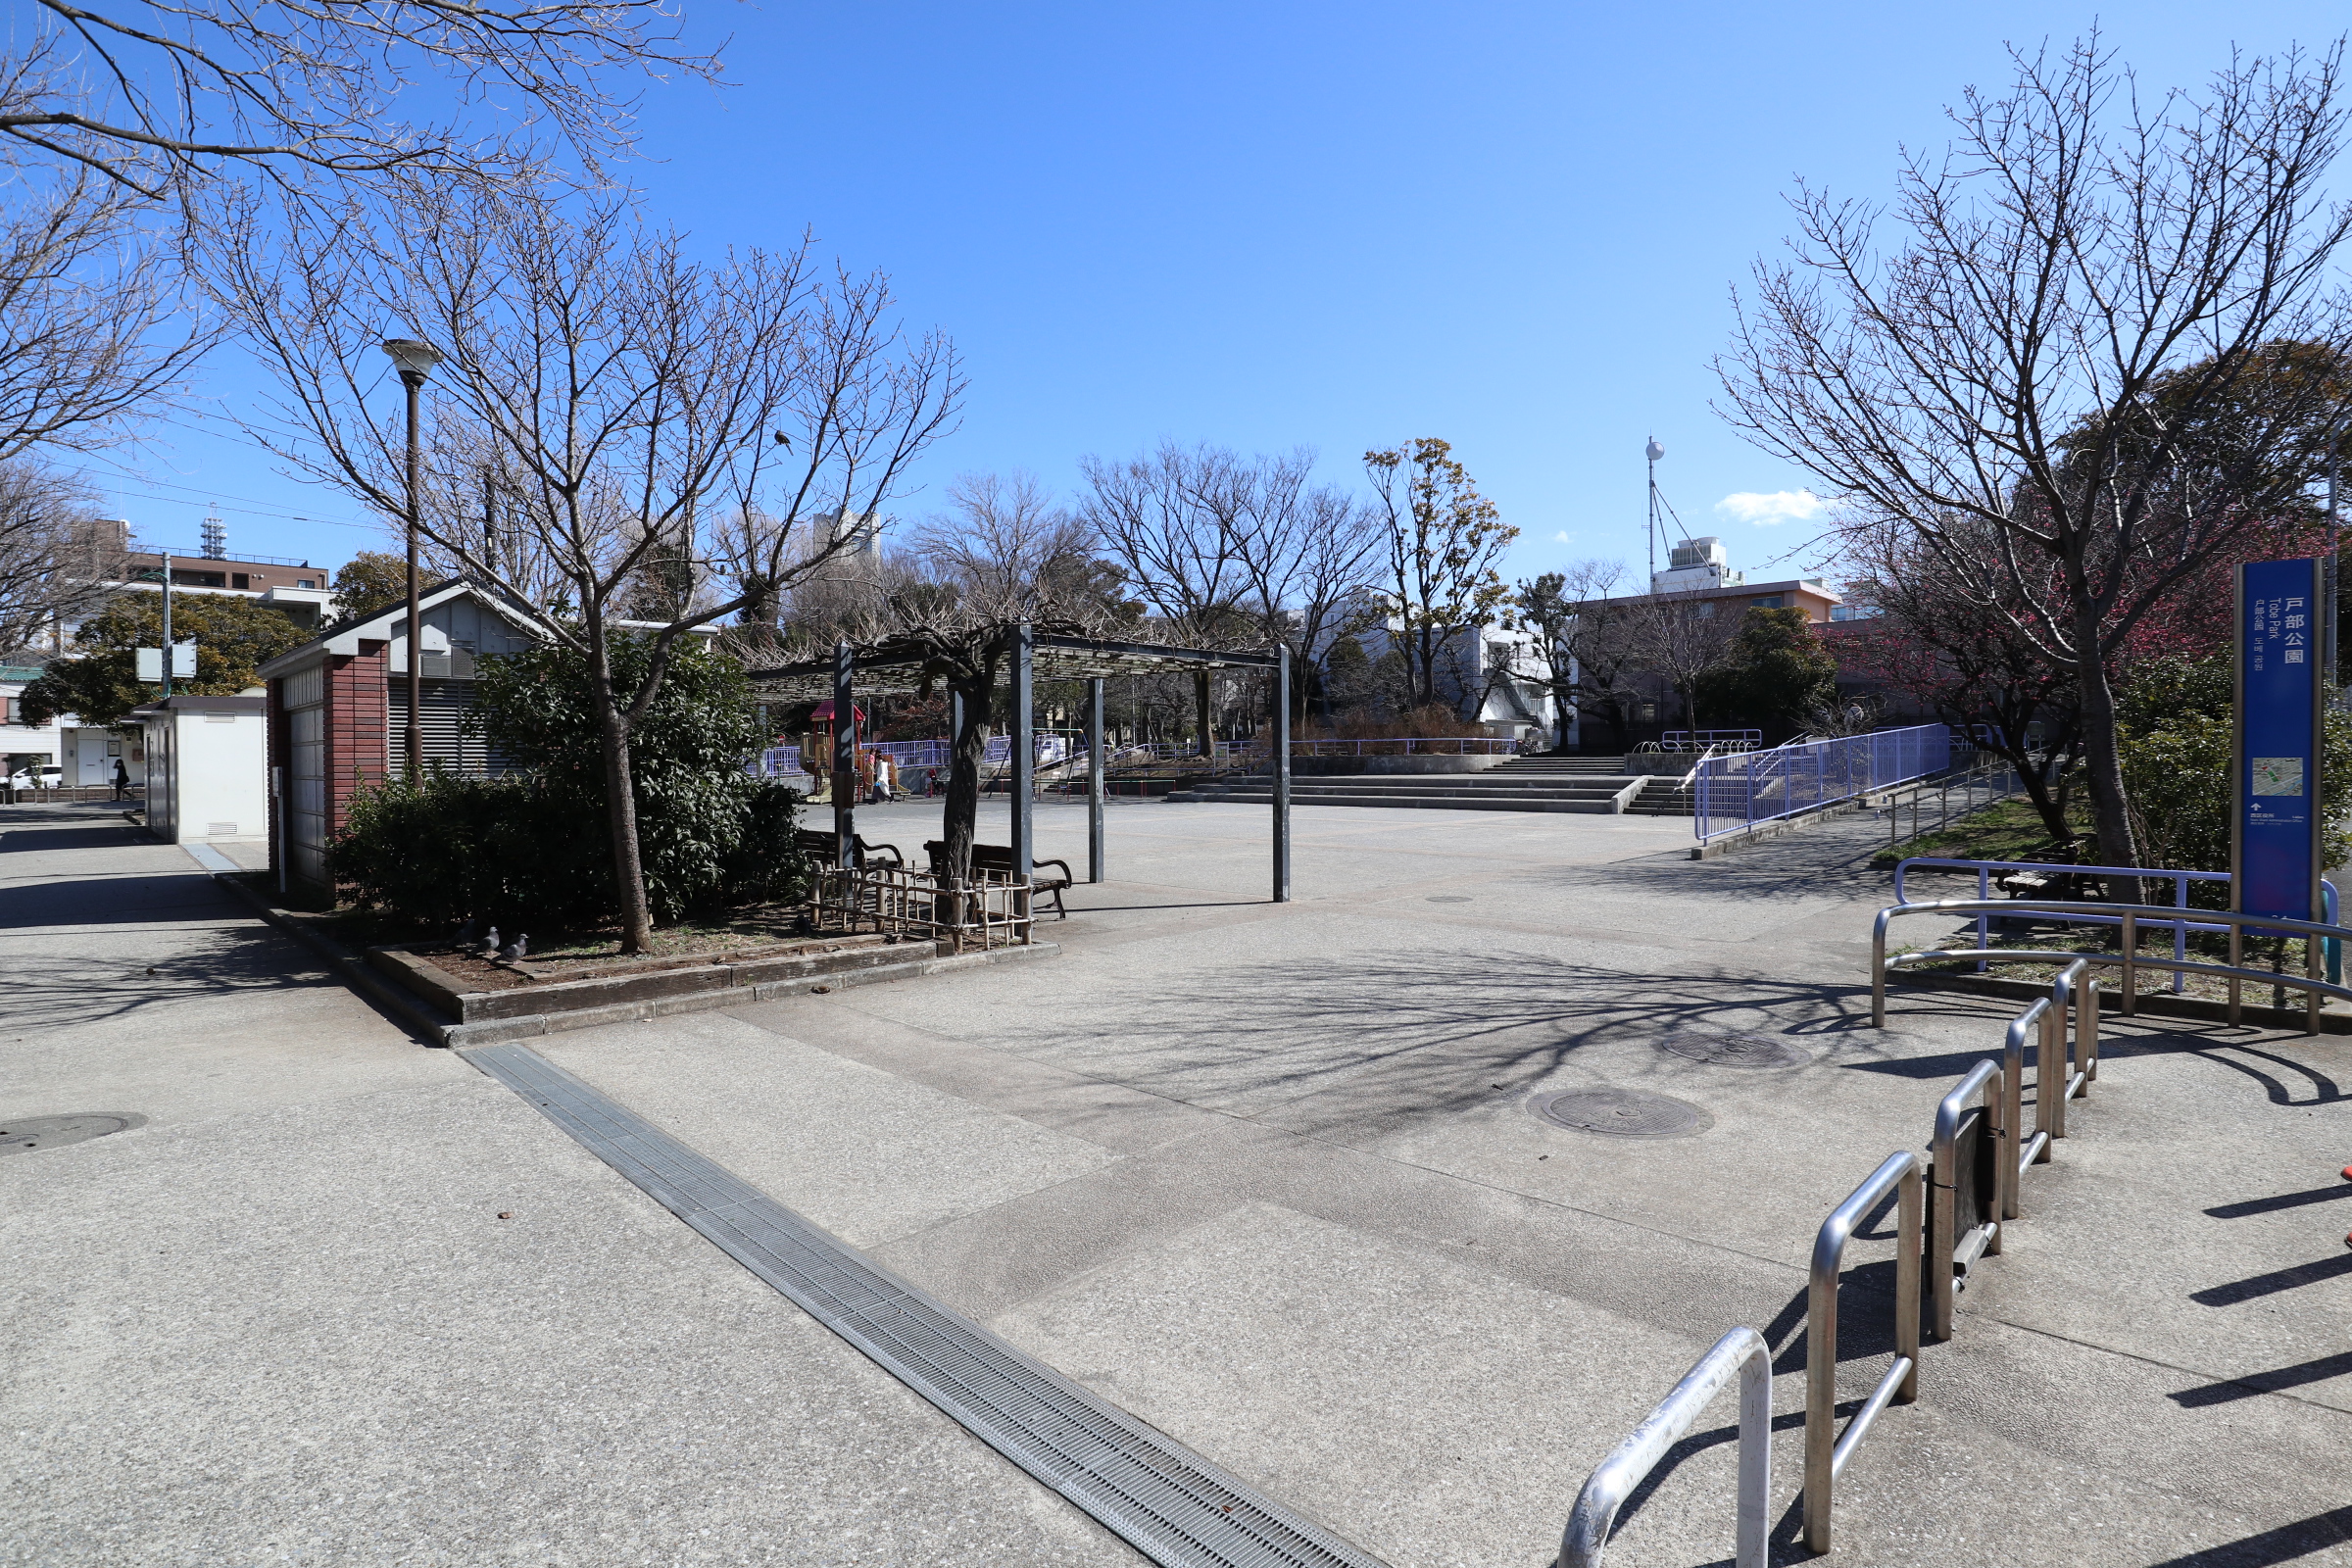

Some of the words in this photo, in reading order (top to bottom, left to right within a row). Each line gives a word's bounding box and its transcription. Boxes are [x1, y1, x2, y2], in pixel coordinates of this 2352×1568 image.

[2269, 598, 2281, 618] Tobe
[2269, 620, 2281, 640] Park
[2284, 597, 2305, 664] 戸部公園
